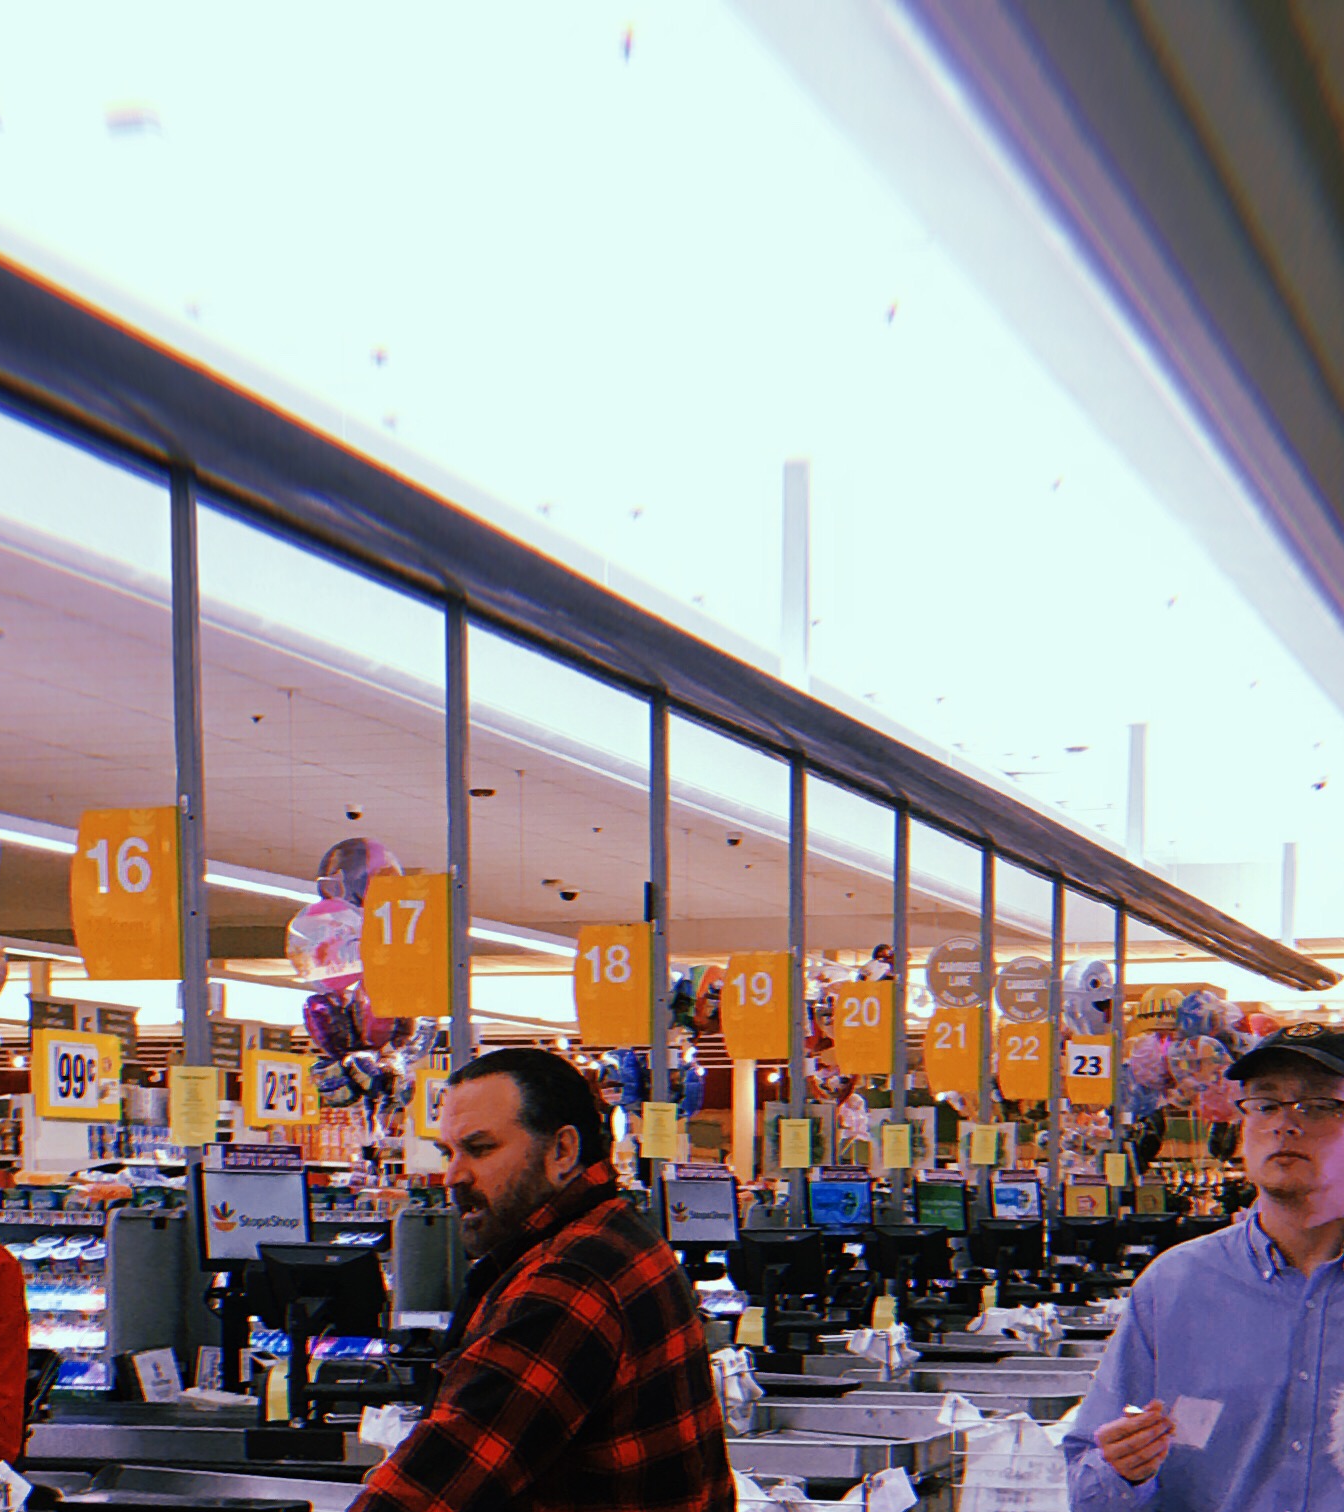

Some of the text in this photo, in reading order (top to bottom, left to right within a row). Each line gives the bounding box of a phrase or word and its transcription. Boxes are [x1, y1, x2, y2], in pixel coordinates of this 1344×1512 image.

[86, 836, 152, 894] 16
[373, 900, 426, 945] 17
[583, 944, 632, 984] 18
[728, 972, 774, 1006] 19
[842, 997, 881, 1028] 20
[934, 1022, 966, 1050] 21
[1007, 1036, 1040, 1061] 22
[1072, 1055, 1102, 1076] 23
